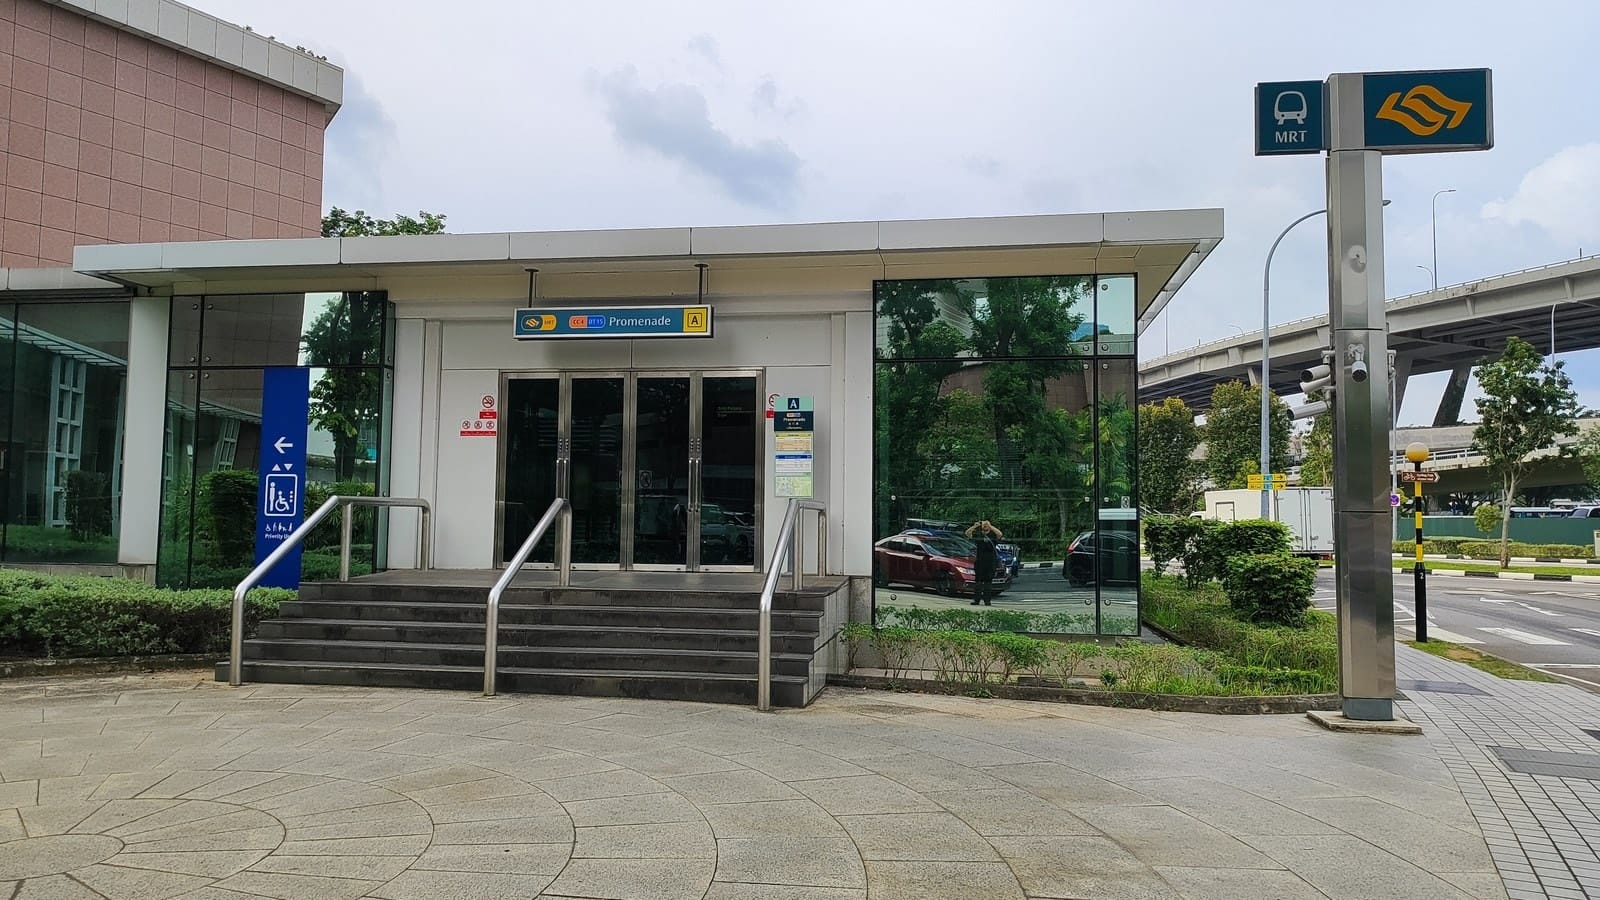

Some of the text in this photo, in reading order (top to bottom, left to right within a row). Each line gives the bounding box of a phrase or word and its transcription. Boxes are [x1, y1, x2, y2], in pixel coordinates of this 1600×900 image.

[1275, 130, 1308, 143] MRT
[609, 315, 671, 326] Promenade
[691, 315, 699, 325] A
[789, 399, 798, 409] A
